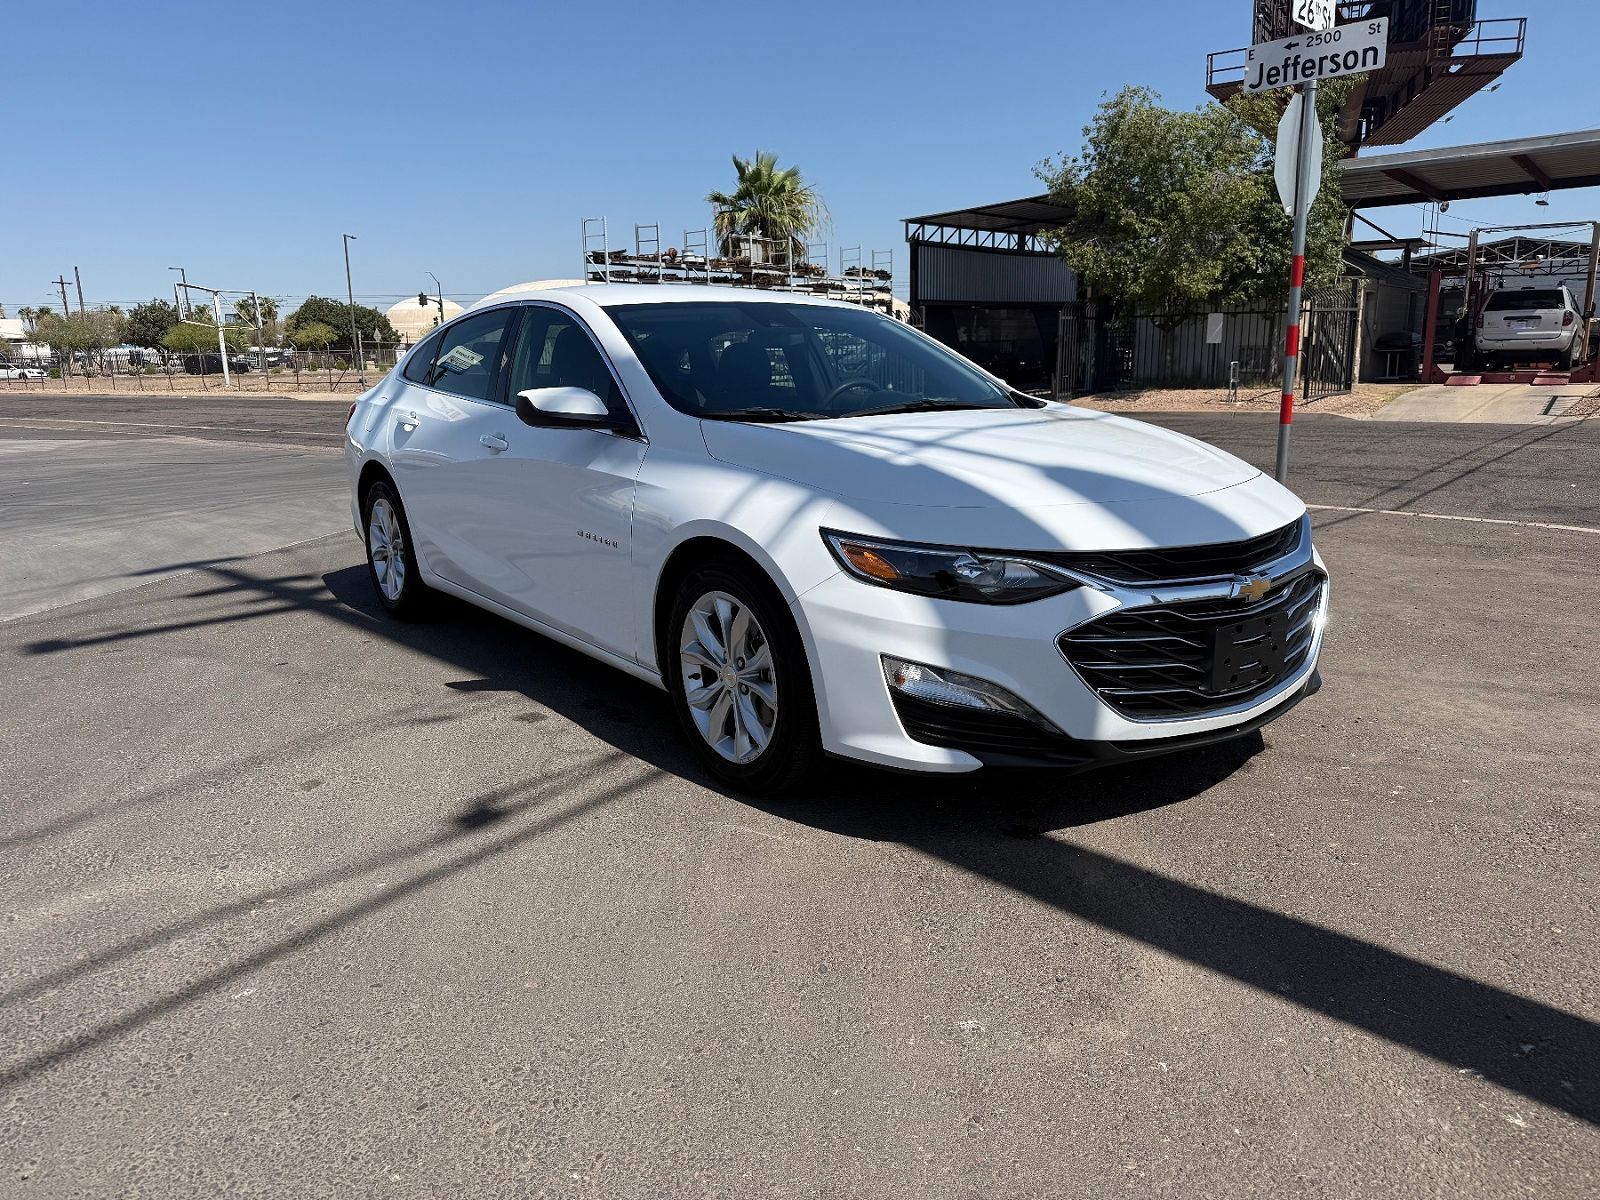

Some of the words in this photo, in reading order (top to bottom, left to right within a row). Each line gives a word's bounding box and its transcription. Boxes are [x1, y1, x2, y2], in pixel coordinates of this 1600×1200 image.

[1298, 0, 1322, 25] 26th
[1321, 5, 1332, 30] St
[1248, 49, 1255, 61] E
[1306, 30, 1342, 48] 2500
[1368, 22, 1382, 35] St
[1248, 46, 1379, 90] Jefferson
